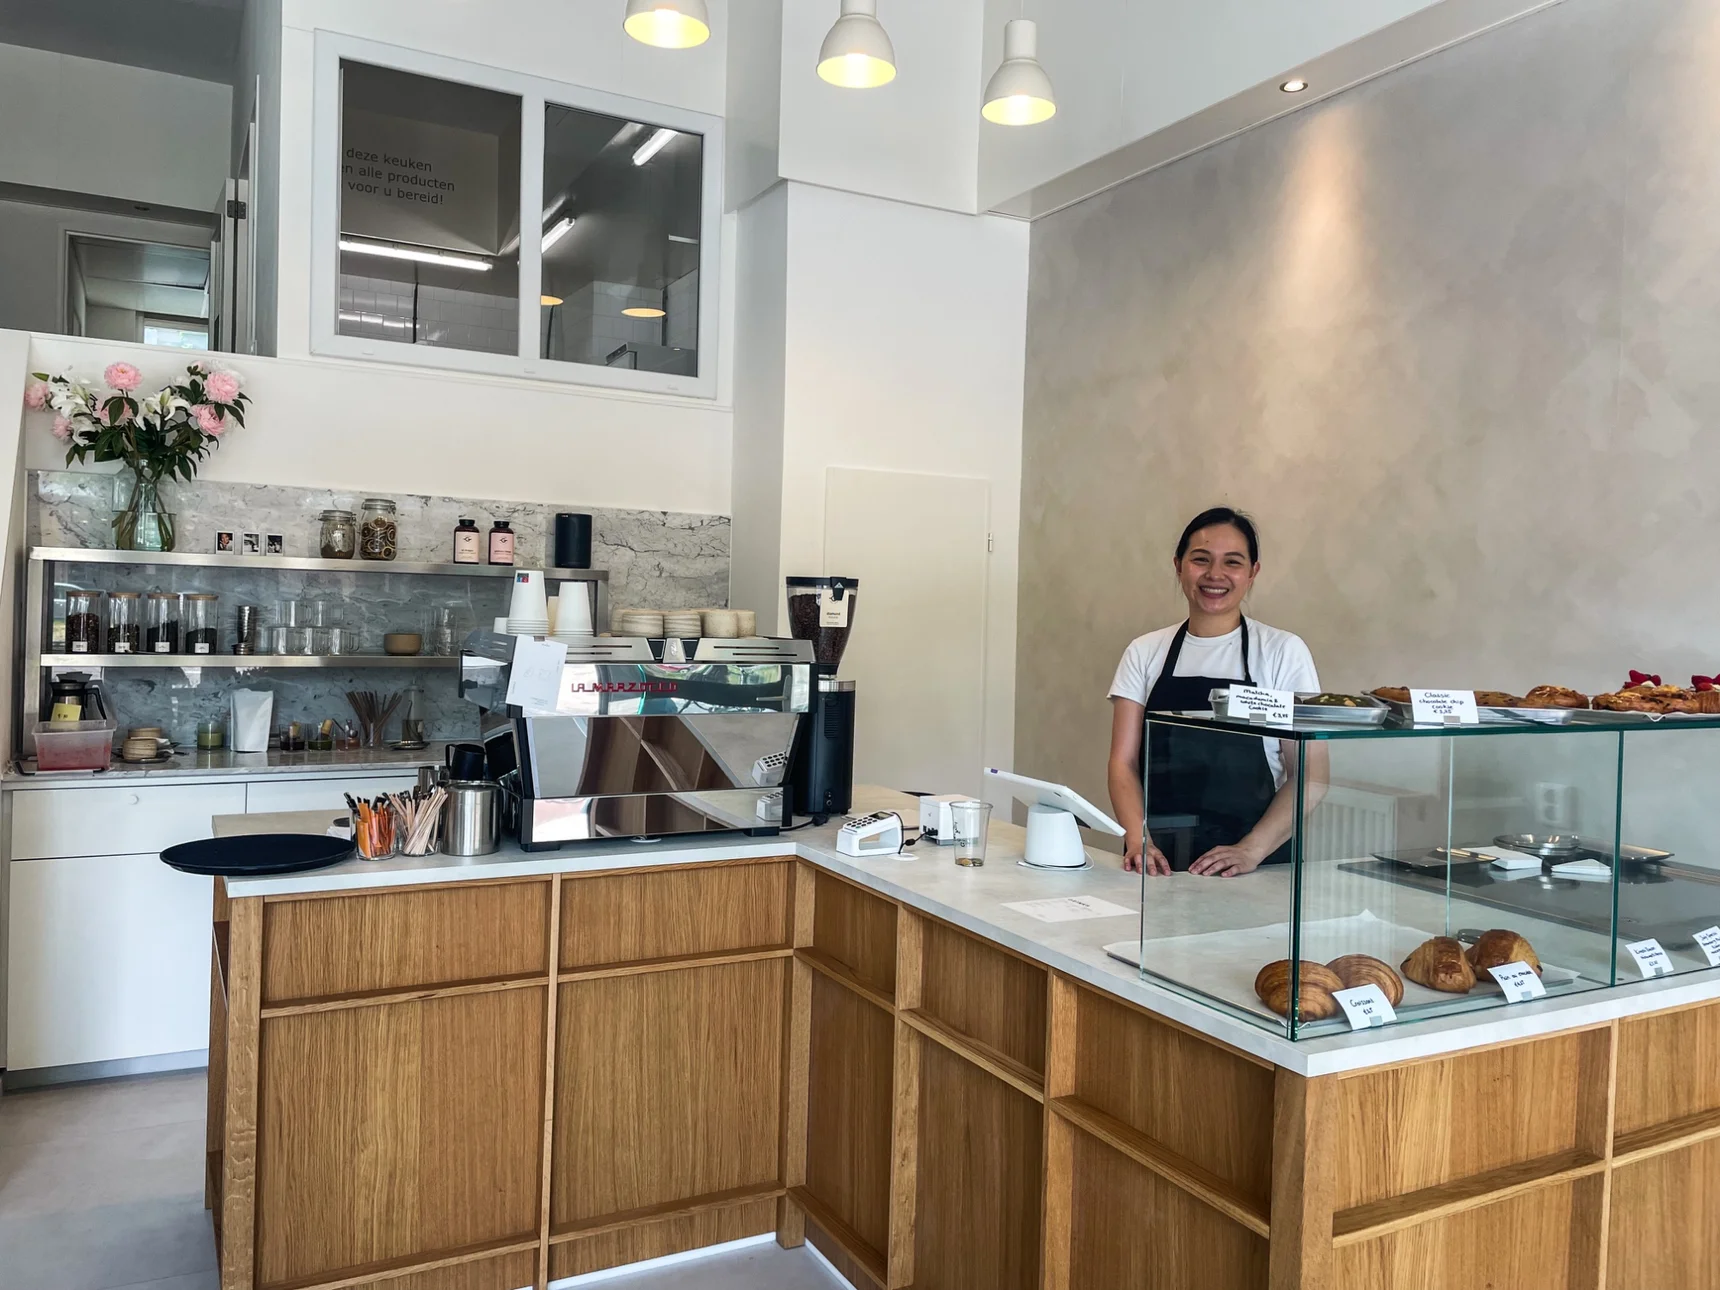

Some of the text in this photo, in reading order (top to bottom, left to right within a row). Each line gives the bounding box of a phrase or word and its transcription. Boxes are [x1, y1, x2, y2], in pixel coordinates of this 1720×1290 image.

[346, 147, 432, 172] deze keuken
[358, 166, 383, 179] alle
[387, 171, 455, 191] producten
[347, 181, 444, 205] voor u bereid!
